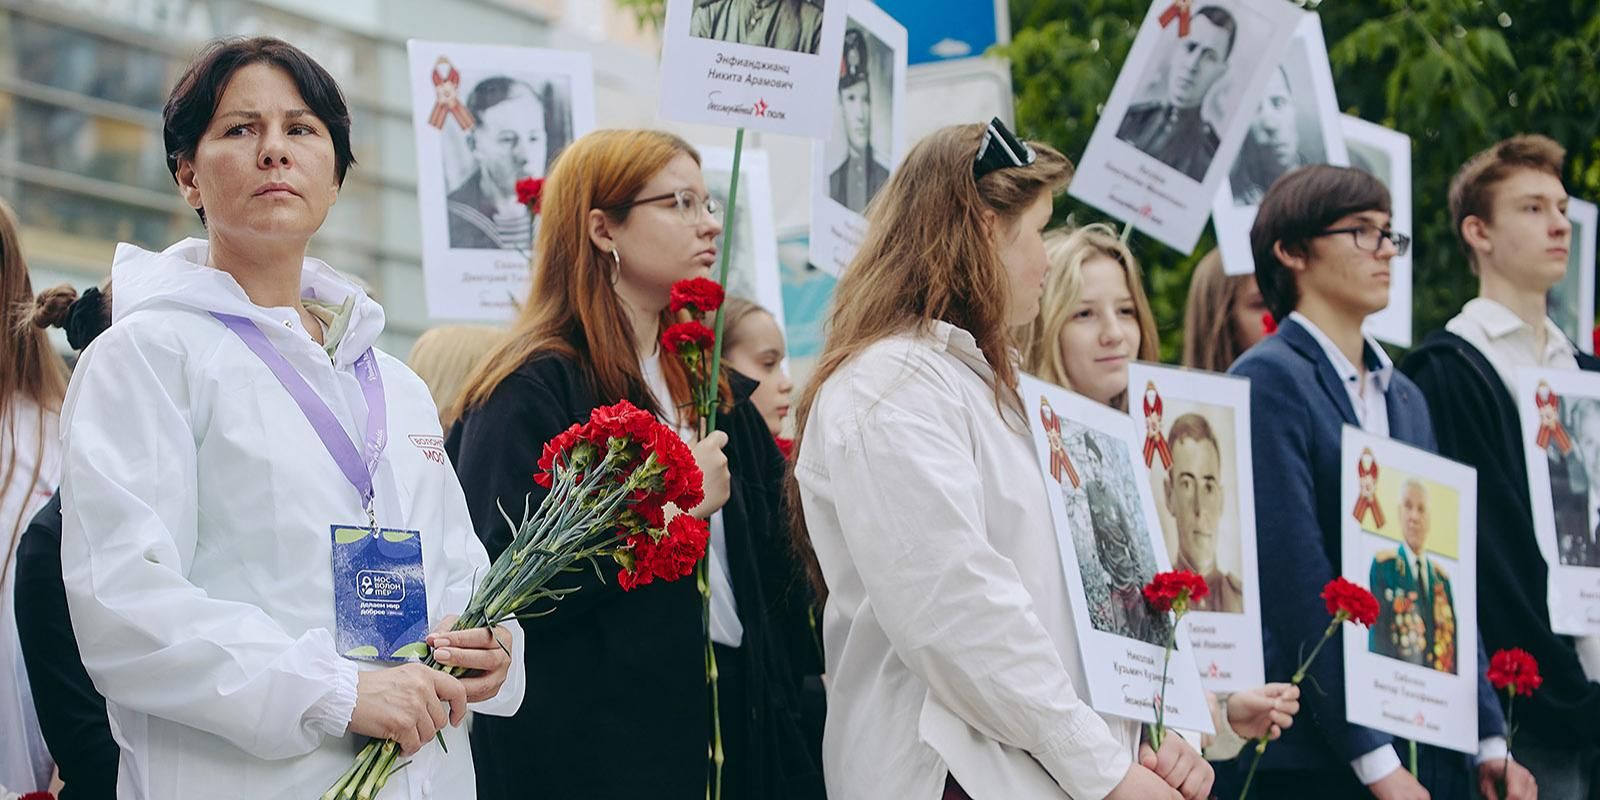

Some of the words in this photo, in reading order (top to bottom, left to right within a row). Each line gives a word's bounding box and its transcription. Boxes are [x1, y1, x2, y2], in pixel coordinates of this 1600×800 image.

[715, 52, 790, 73] Энфианджианц
[707, 68, 742, 83] Никита
[745, 74, 794, 90] Арамович
[766, 109, 786, 120] полк
[360, 608, 386, 616] добрее
[386, 603, 400, 611] мир
[1126, 650, 1155, 665] Николай
[1113, 661, 1143, 677] Кузьмич
[1144, 670, 1174, 685] Кузнеов
